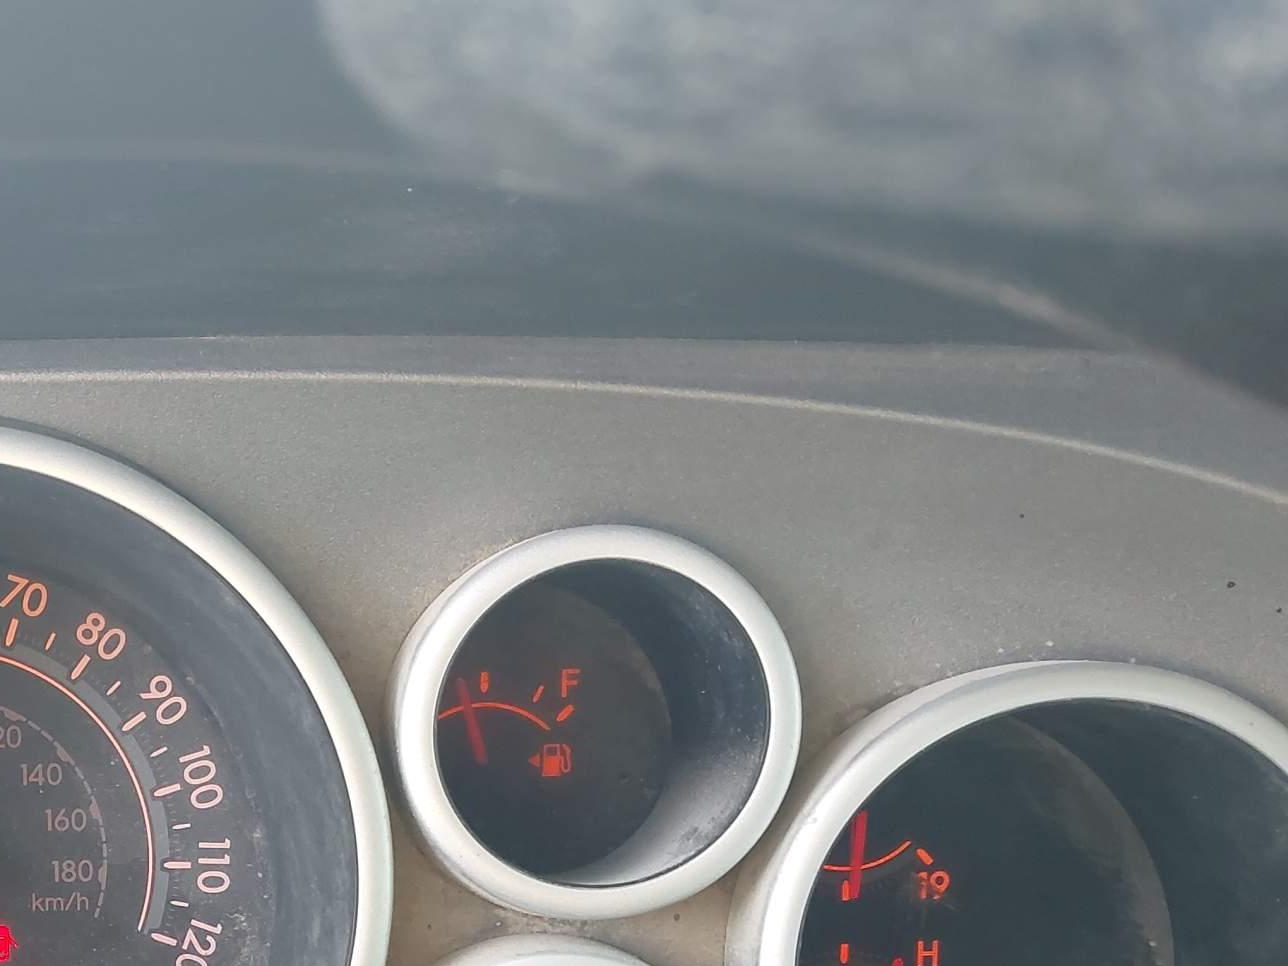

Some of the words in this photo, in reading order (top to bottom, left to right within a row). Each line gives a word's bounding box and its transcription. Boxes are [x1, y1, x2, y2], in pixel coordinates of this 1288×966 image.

[76, 612, 126, 661] 80
[562, 668, 581, 698] F
[139, 675, 187, 725] 90
[20, 763, 62, 786] 140
[179, 744, 224, 809] 100
[45, 808, 87, 832] 160
[52, 860, 94, 884] 180
[196, 838, 231, 894] 110
[31, 892, 89, 913] km/h
